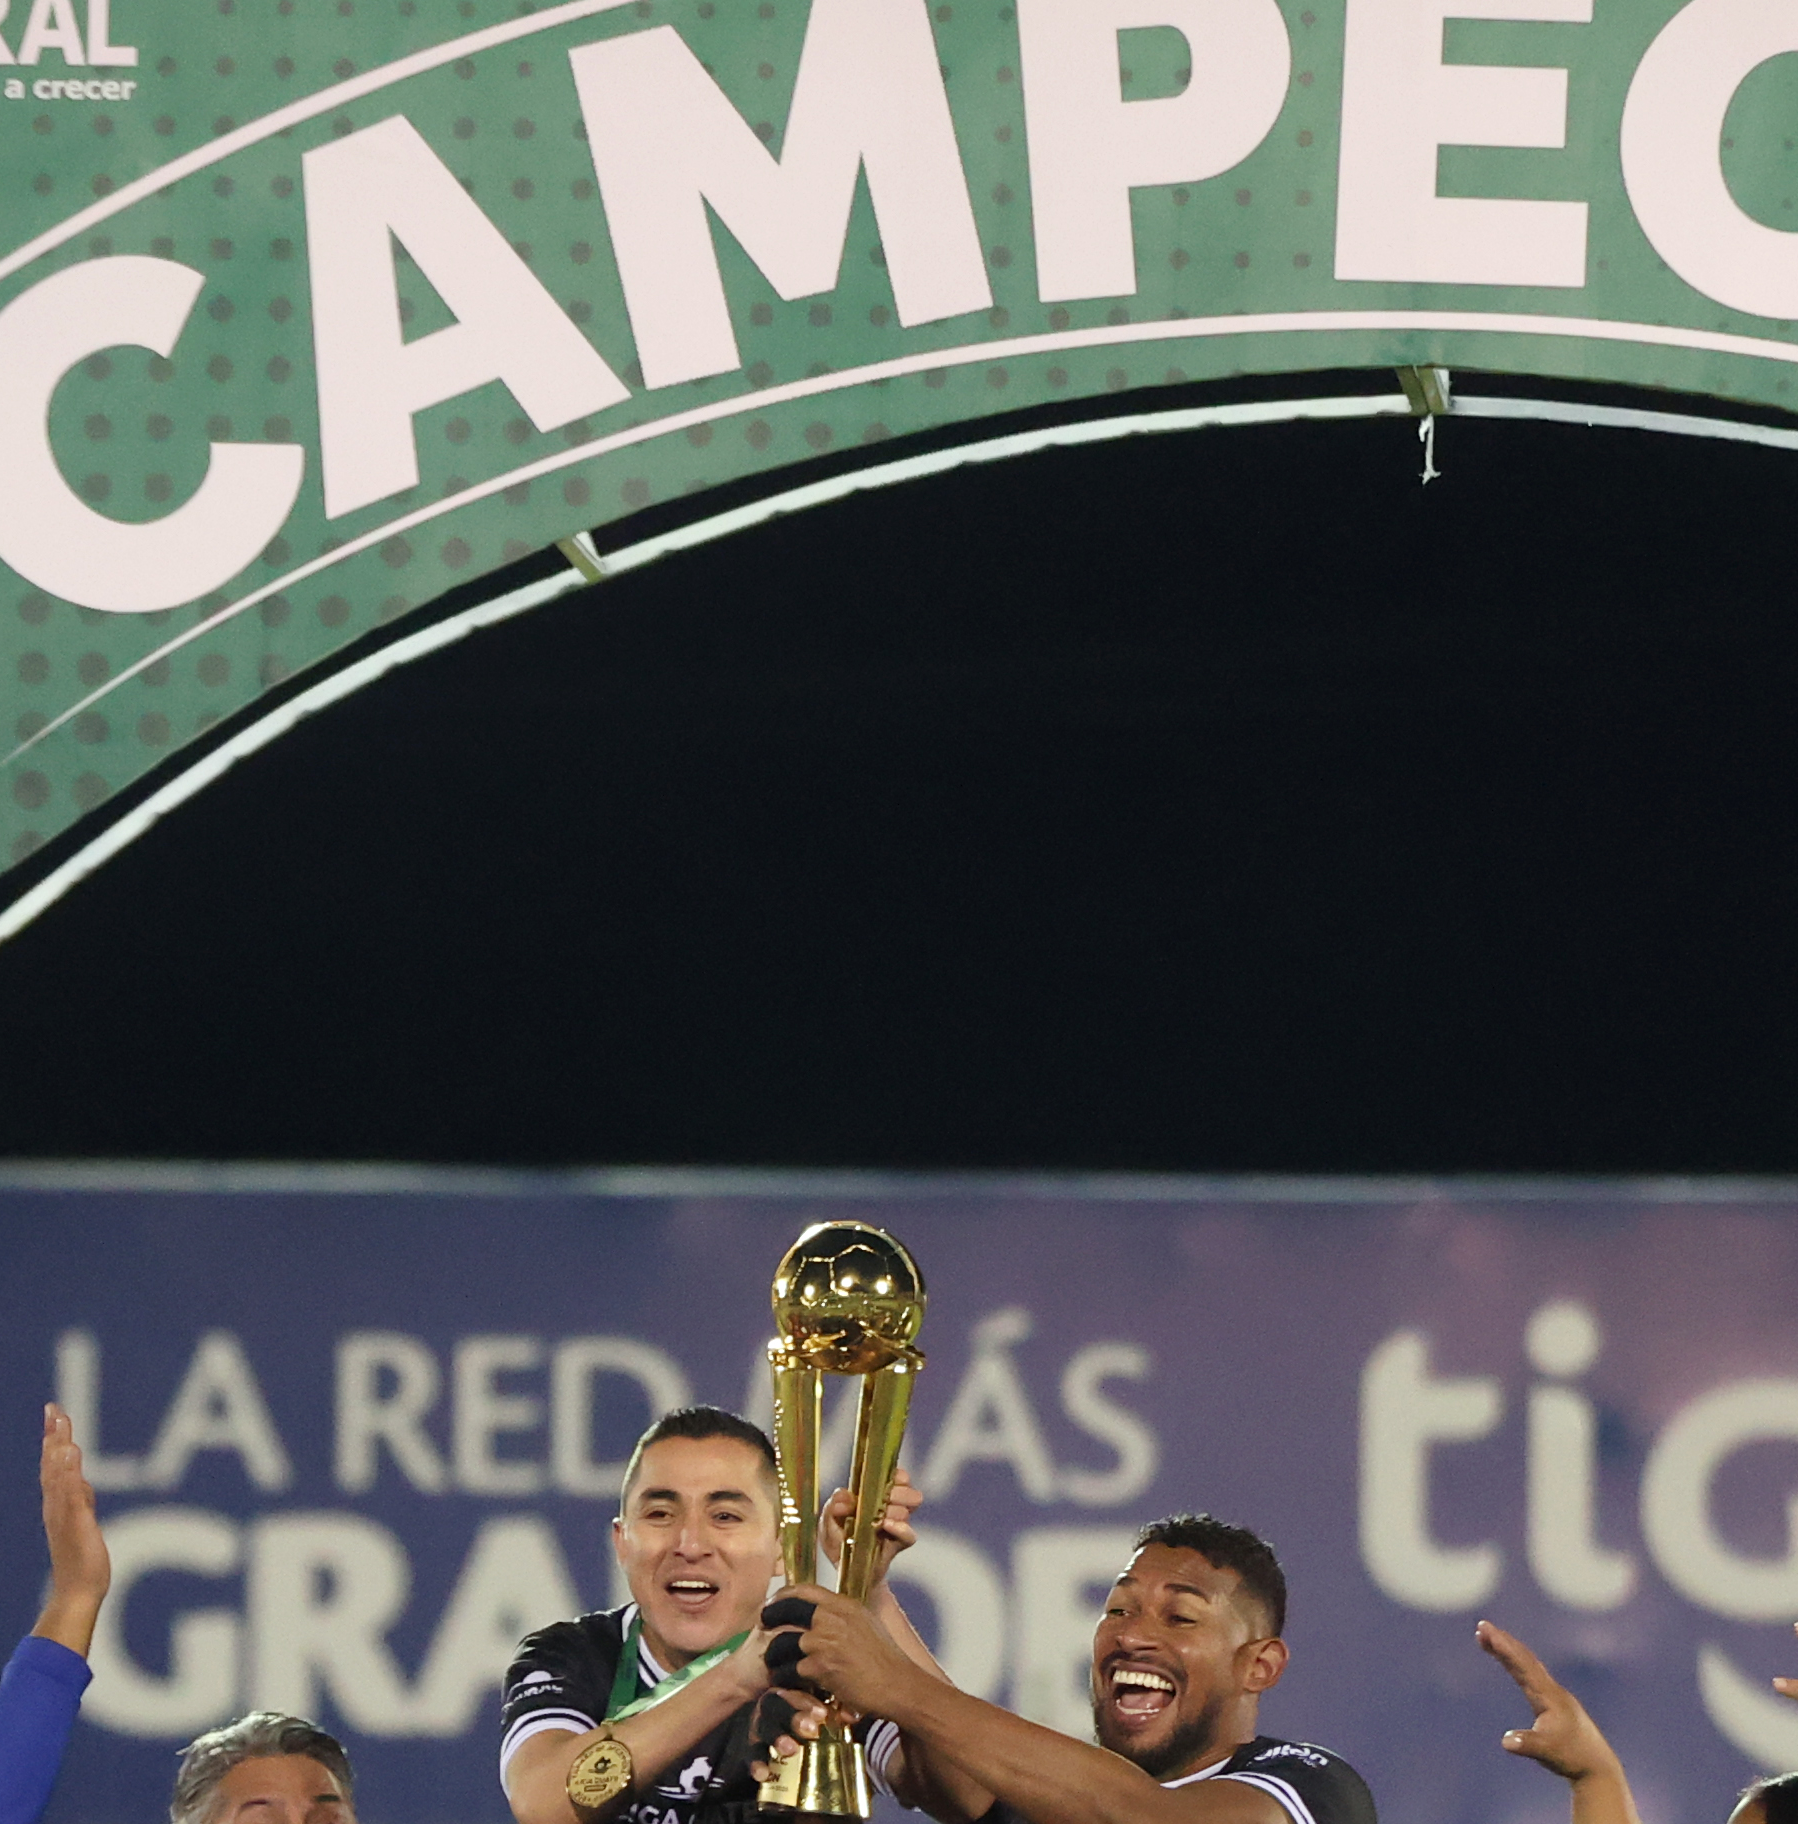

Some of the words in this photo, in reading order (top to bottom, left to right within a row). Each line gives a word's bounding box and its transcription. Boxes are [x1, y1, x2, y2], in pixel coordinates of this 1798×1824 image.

[4, 77, 26, 100] a
[33, 76, 136, 102] crecer
[55, 1330, 290, 1492] LA
[335, 1330, 681, 1496] RED
